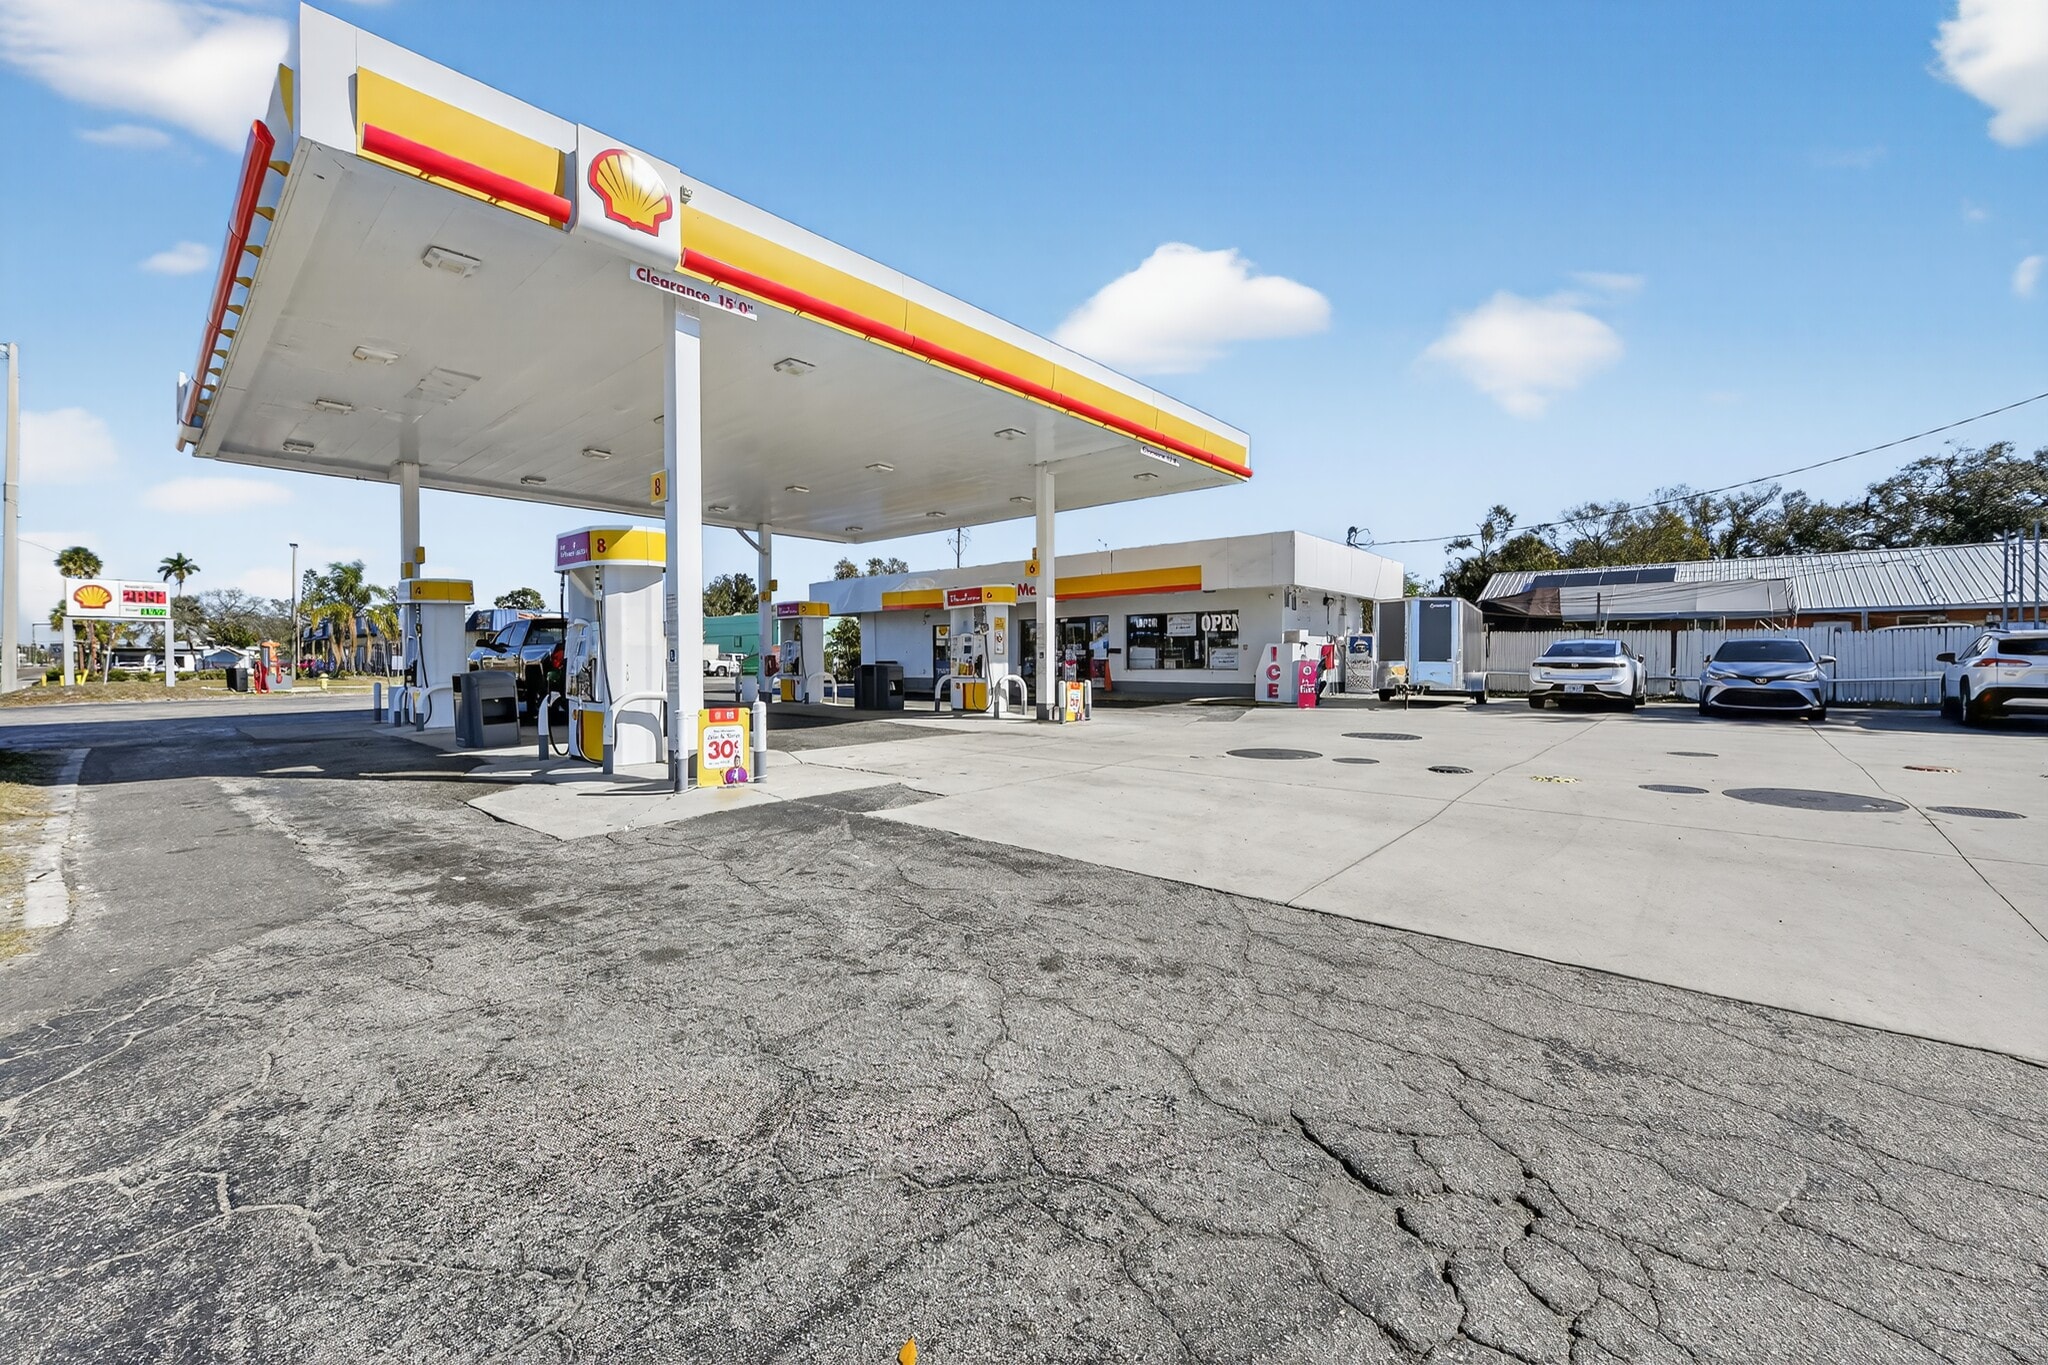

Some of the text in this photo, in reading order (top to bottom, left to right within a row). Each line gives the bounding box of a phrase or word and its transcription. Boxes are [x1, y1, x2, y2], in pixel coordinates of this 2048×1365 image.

[636, 267, 710, 302] Clearance
[654, 477, 661, 496] 8
[597, 537, 607, 553] 8
[1029, 564, 1036, 574] 6
[1201, 613, 1239, 632] OPEN
[1266, 646, 1281, 699] ICE
